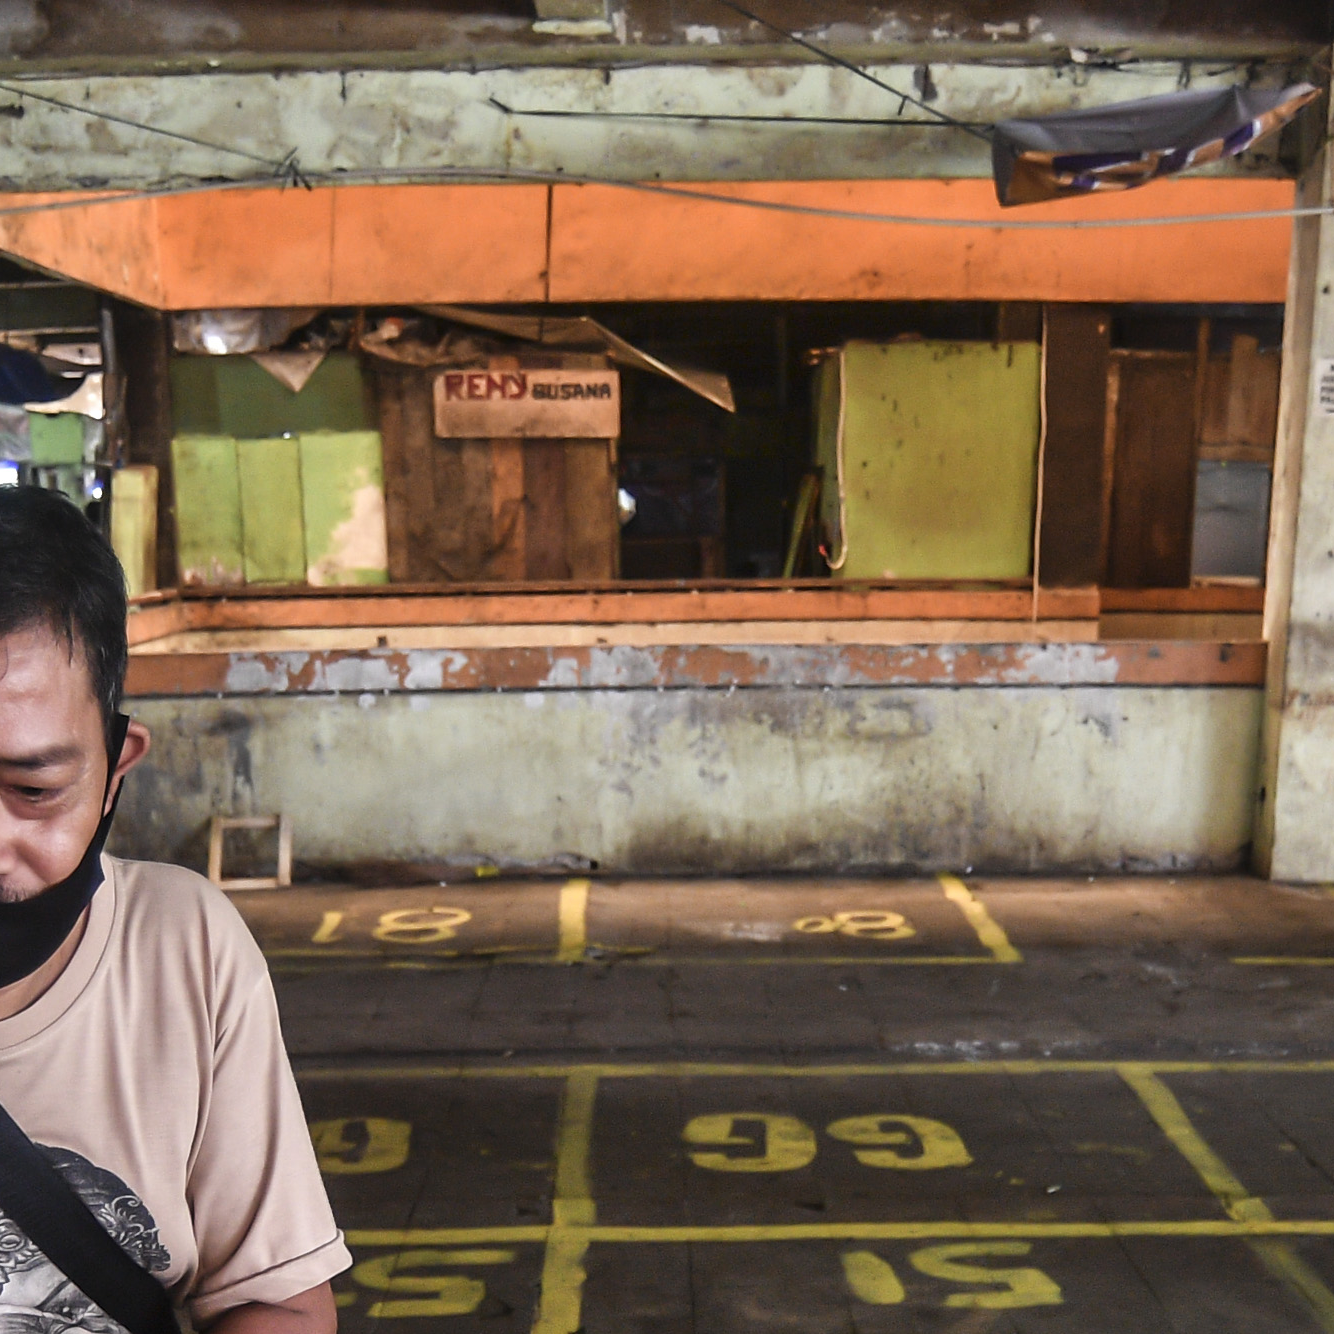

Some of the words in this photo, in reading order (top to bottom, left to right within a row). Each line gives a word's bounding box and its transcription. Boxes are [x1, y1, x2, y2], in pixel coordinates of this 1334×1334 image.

[445, 373, 527, 400] RENY
[532, 382, 612, 400] BUSANA
[312, 906, 471, 943] 81
[309, 1116, 412, 1174] 6
[682, 1112, 973, 1172] 66
[333, 1248, 516, 1318] 5
[840, 1240, 1062, 1310] 51
